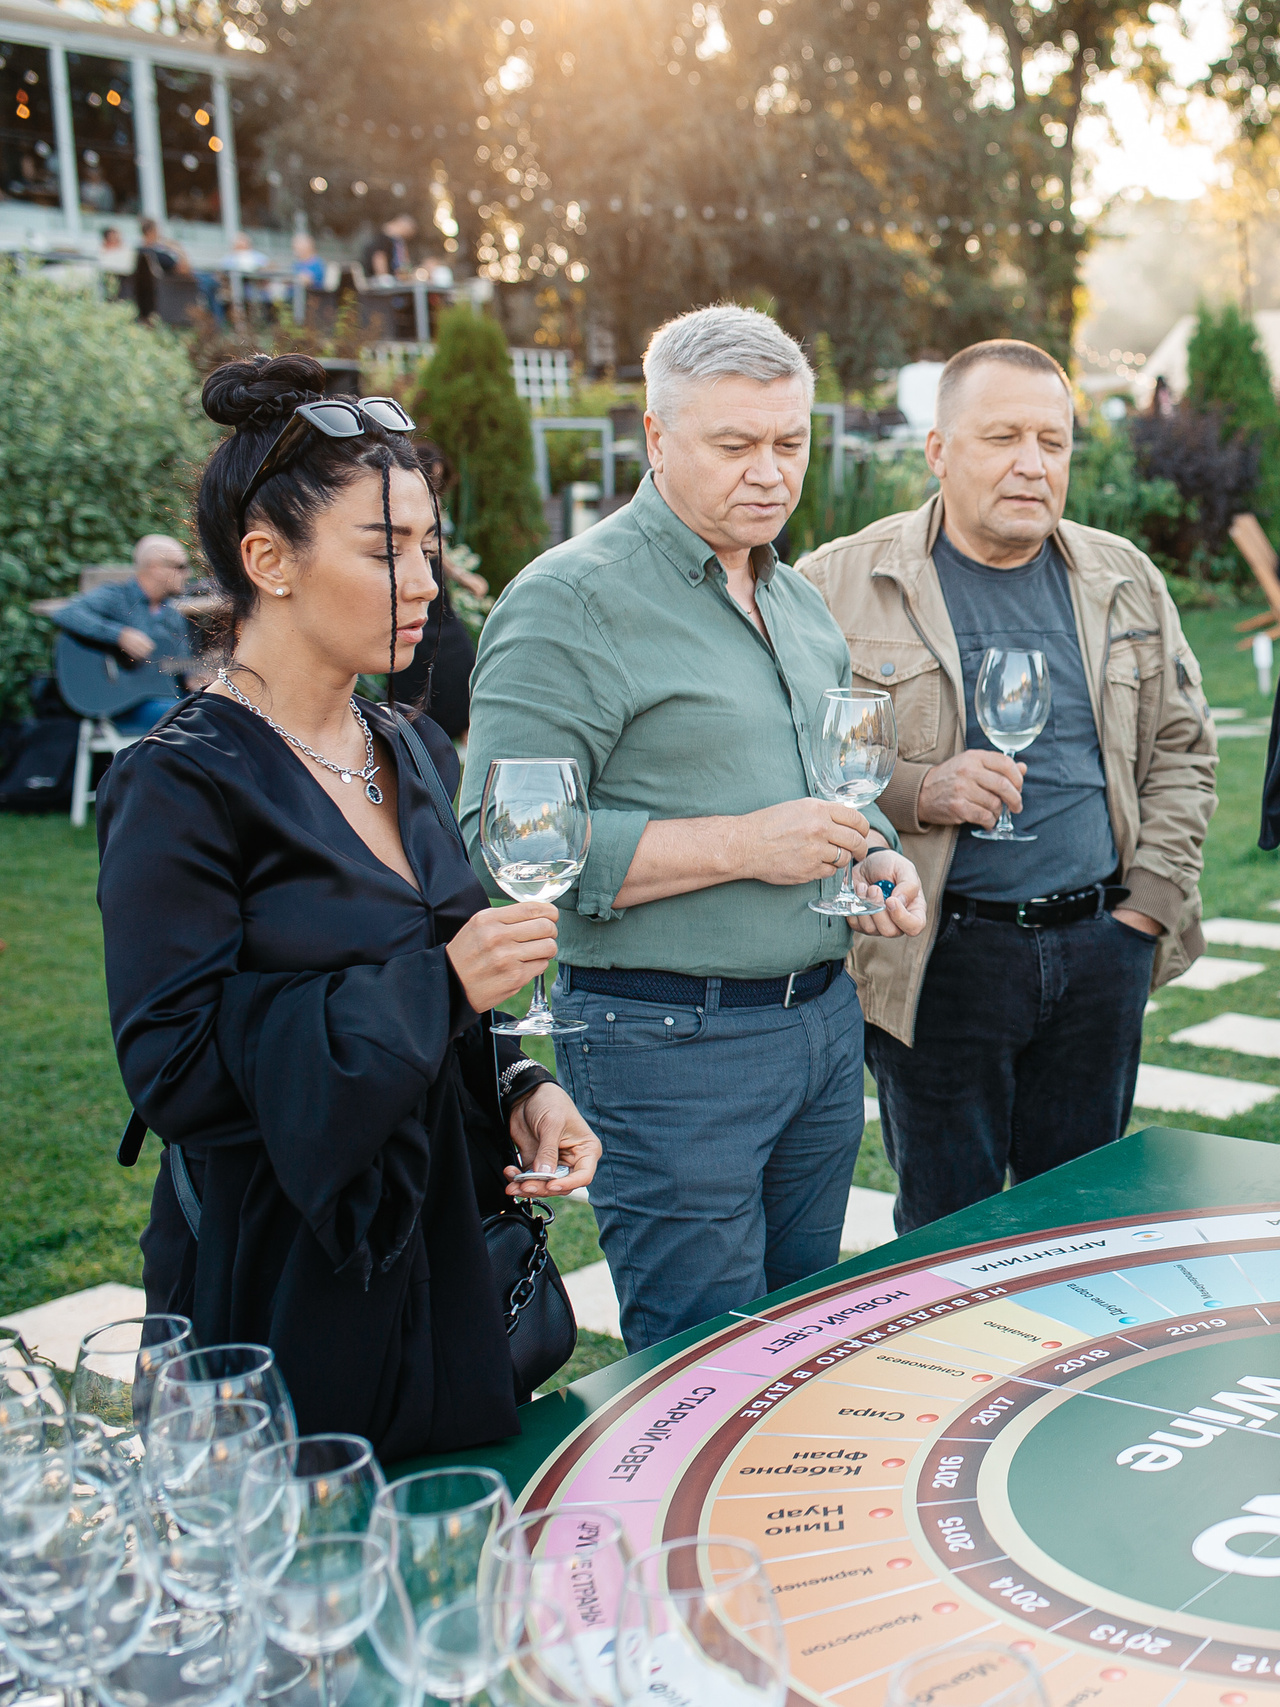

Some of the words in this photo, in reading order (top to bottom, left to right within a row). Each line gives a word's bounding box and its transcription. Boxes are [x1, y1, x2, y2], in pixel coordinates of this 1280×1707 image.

[971, 1239, 1107, 1272] АРГЕНТИНА
[971, 1286, 1008, 1301] НЕ
[1066, 1283, 1094, 1298] сорта
[819, 1290, 911, 1325] НОВЫЙ
[1091, 1297, 1128, 1316] Другие
[761, 1325, 824, 1355] СВЕТ
[816, 1298, 971, 1366] ВЫДЕРЖАНО
[983, 1320, 1042, 1343] Канайоло
[1165, 1318, 1227, 1336] 2019
[792, 1370, 814, 1380] В
[876, 1354, 965, 1377] Санджовезе
[1054, 1349, 1110, 1374] 2018
[639, 1386, 717, 1442] СТАРЫЙ
[740, 1382, 794, 1419] ДУБЕ
[970, 1396, 1015, 1427] 2017
[837, 1407, 906, 1422] Сира
[608, 1444, 655, 1483] СВЕТ
[792, 1449, 868, 1461] Фран
[739, 1464, 863, 1477] Каберне
[932, 1455, 965, 1489] 2016
[767, 1504, 844, 1520] Нуар
[764, 1520, 845, 1536] Пино
[937, 1516, 976, 1553] 2015
[769, 1566, 873, 1596] Карменер
[989, 1576, 1050, 1612] 2014
[1089, 1624, 1172, 1655] 2013
